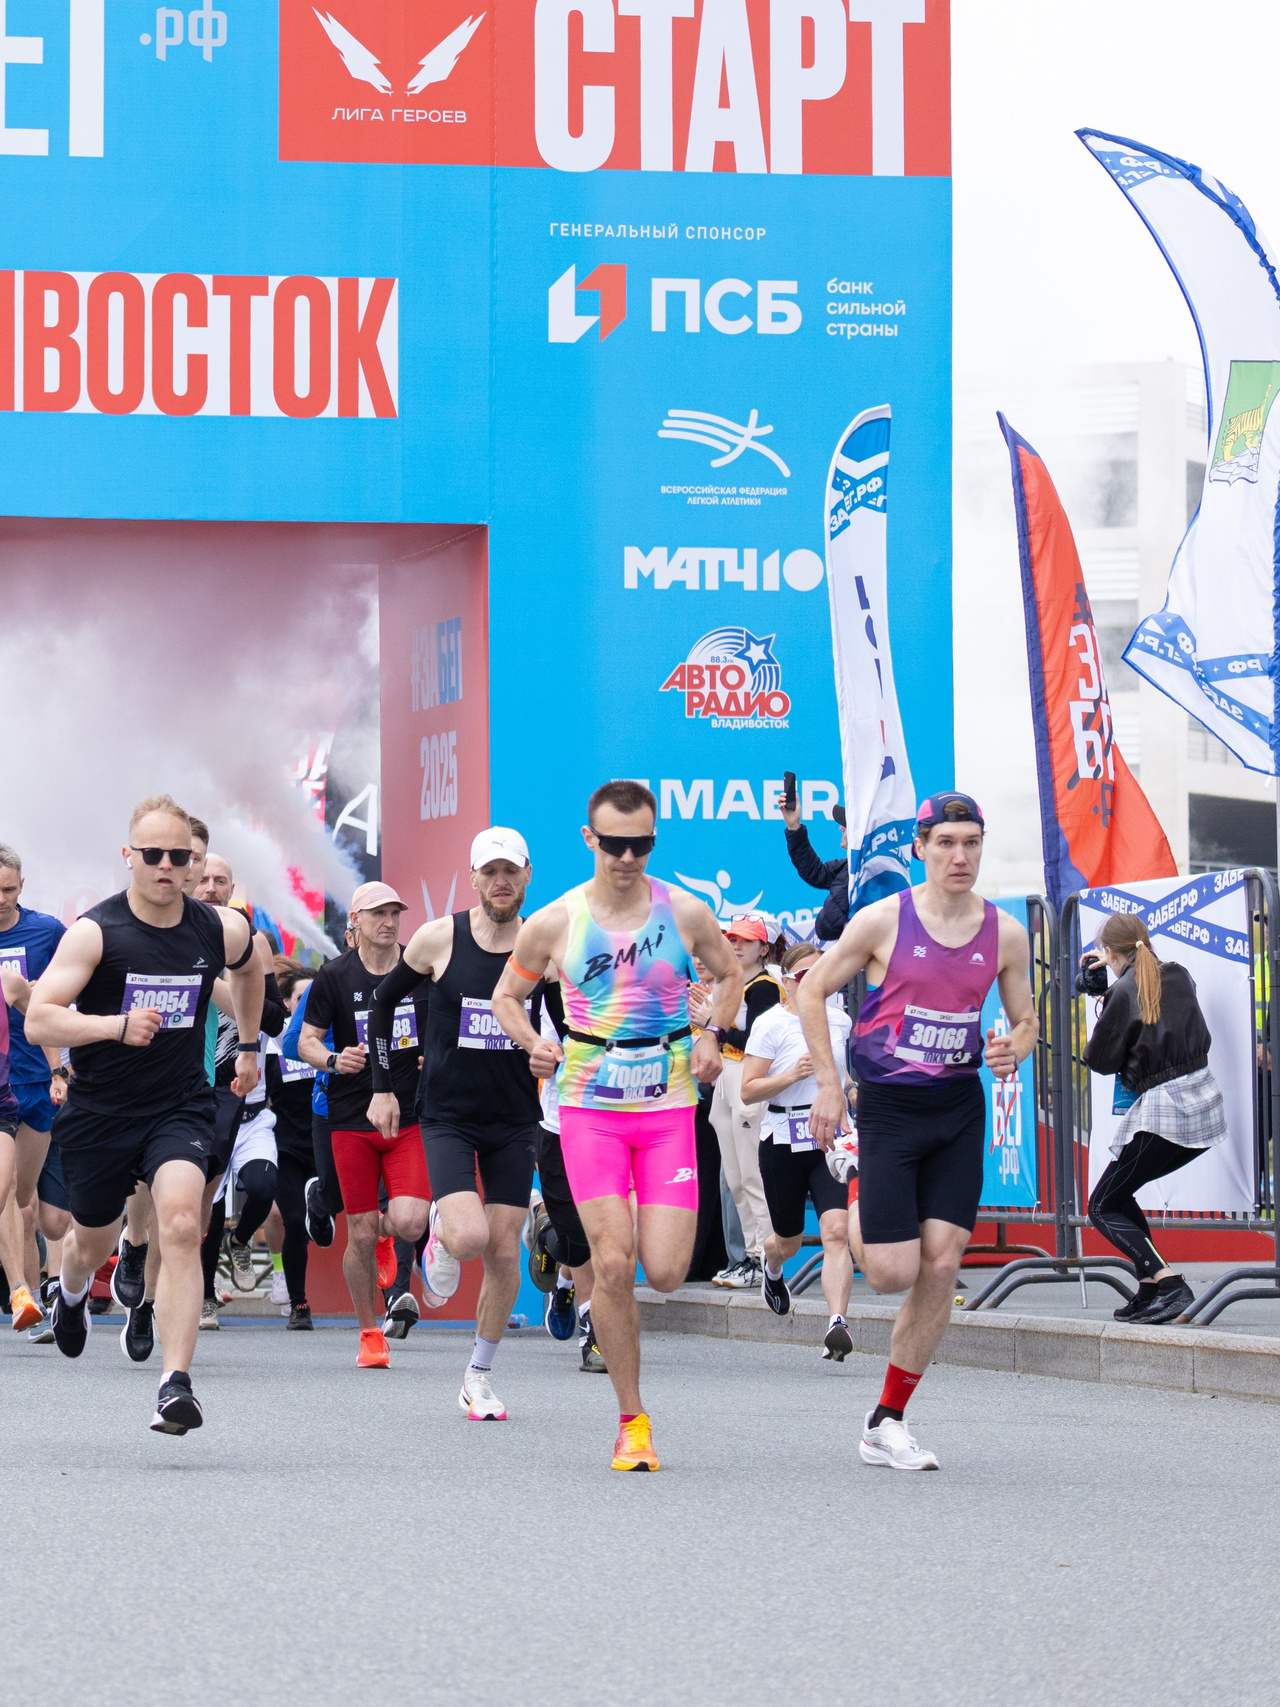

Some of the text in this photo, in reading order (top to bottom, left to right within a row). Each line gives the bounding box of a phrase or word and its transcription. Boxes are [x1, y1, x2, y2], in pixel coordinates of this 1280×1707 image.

[534, 0, 907, 176] СТАРТ
[331, 107, 467, 123] ЛИГА ГЕРОЕВ
[550, 222, 767, 241] ГЕНЕРАЛЬНЫЙ СПОНСОР
[826, 277, 874, 295] банк
[651, 277, 803, 335] ПСБ
[826, 298, 906, 316] сильной
[826, 322, 899, 340] страны
[660, 485, 788, 496] ВСЕРОССИЙСКАЯ ФЕДЕРАЦИЯ
[686, 496, 762, 506] ЛЕГКОЙ АТЛЕТИКИ
[660, 664, 746, 691] АВТО
[686, 691, 791, 718] РАДИО
[711, 719, 790, 730] ВЛАДИВОСТОК
[420, 730, 458, 821] 2025
[1147, 888, 1199, 932] ЗАБЕГ.РФ
[1167, 919, 1210, 945] АБЕГ.РФ
[131, 990, 189, 1013] 30954
[468, 1013, 508, 1036] 305
[909, 1022, 968, 1050] 30168
[606, 1061, 663, 1090] 70020
